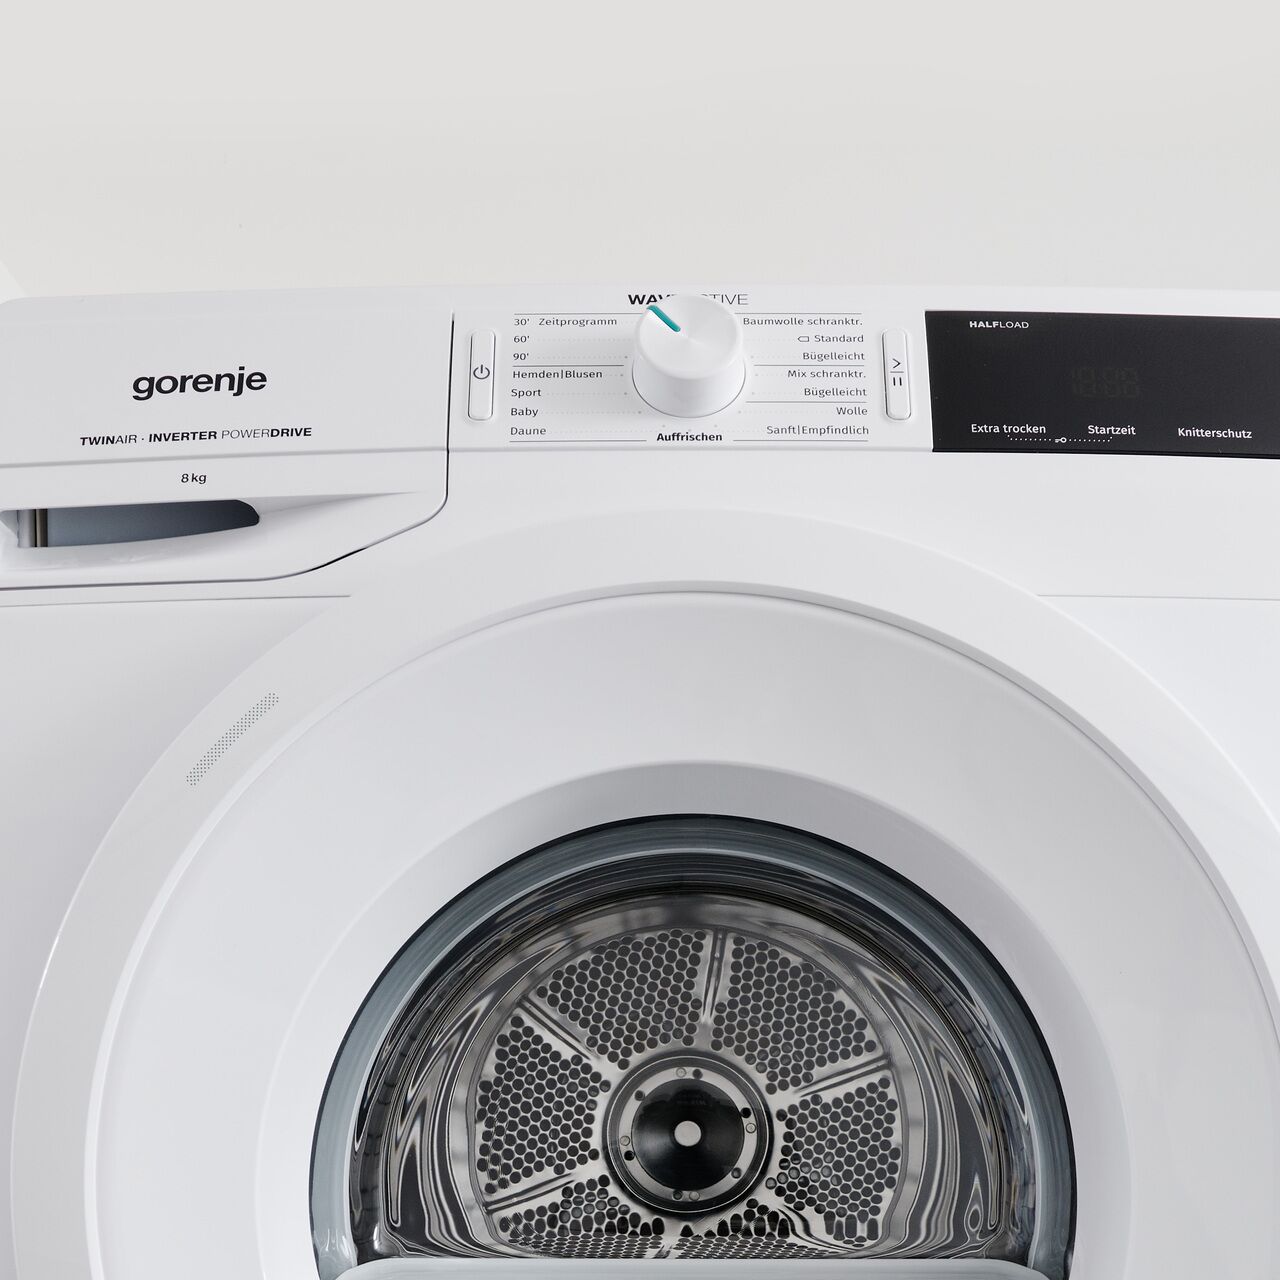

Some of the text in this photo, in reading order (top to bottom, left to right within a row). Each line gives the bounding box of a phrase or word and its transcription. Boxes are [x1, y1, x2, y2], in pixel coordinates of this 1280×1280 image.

[513, 316, 618, 328] 30' Zeitprogramm
[742, 316, 864, 327] Baumwolle schranktr.
[969, 320, 1030, 330] HALFLOAD
[513, 333, 531, 344] 60'
[814, 333, 865, 344] Standard
[512, 351, 530, 362] 90'
[802, 350, 865, 363] Bügelleicht
[512, 368, 603, 381] Hemden|Blusen
[787, 368, 866, 380] Mix schranktr.
[132, 365, 268, 402] gorenje
[511, 387, 542, 400] Sport
[803, 386, 867, 400] Bügelleicht
[510, 405, 539, 419] Baby
[835, 405, 868, 417] Wolle
[510, 425, 547, 436] Daune
[766, 423, 870, 437] Sanft|Empfindlich
[970, 423, 1047, 435] Extra trocken
[1087, 424, 1137, 436] Startzeit
[1177, 427, 1253, 440] Knitterschutz
[79, 426, 313, 446] TWINAIR INVERTER POWERDRIVE
[656, 431, 723, 444] Auffrischen
